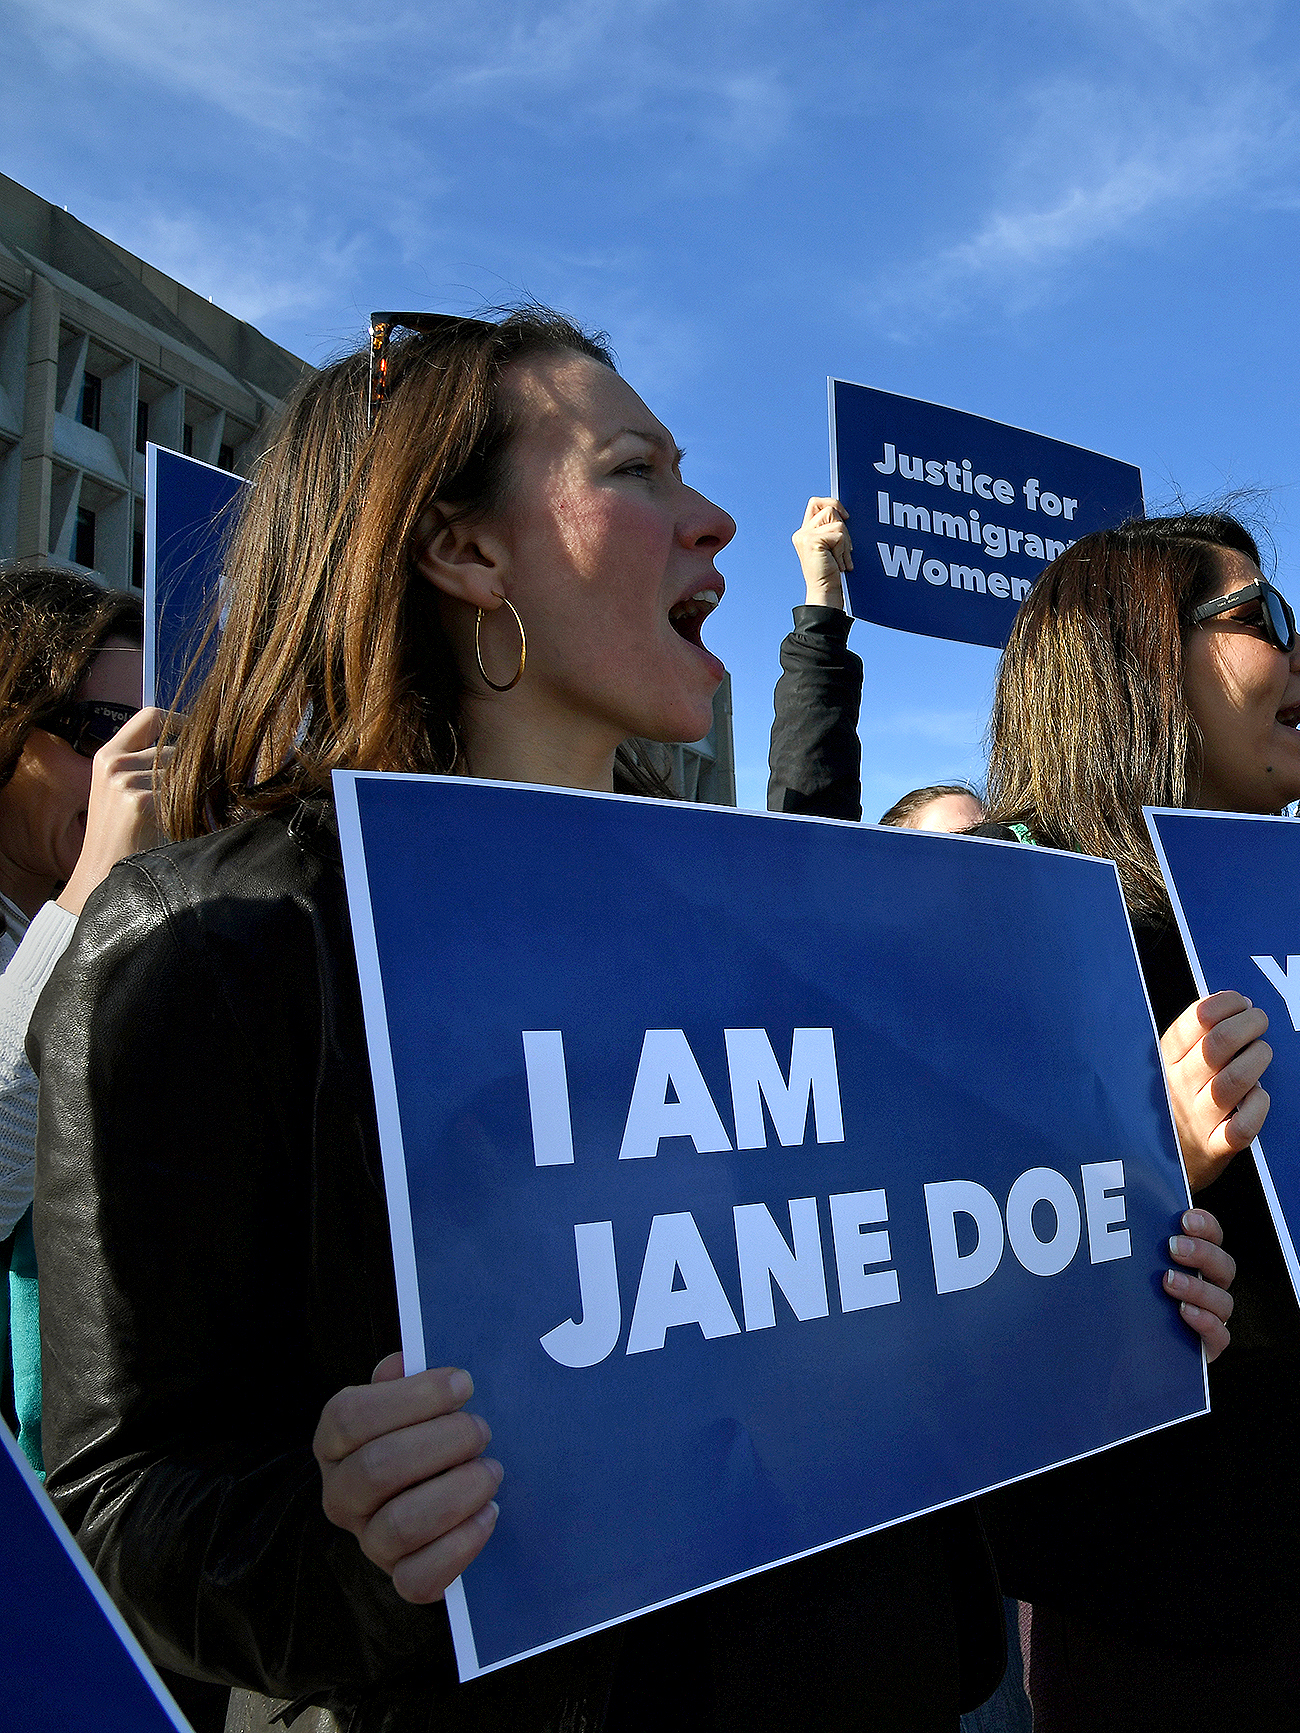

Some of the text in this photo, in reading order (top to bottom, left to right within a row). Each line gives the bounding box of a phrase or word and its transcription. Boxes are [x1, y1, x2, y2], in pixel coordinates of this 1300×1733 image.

[873, 442, 1078, 521] Justice for
[876, 541, 1036, 602] Women
[521, 1027, 845, 1167] I AM
[539, 1159, 1132, 1369] JANE DOE
